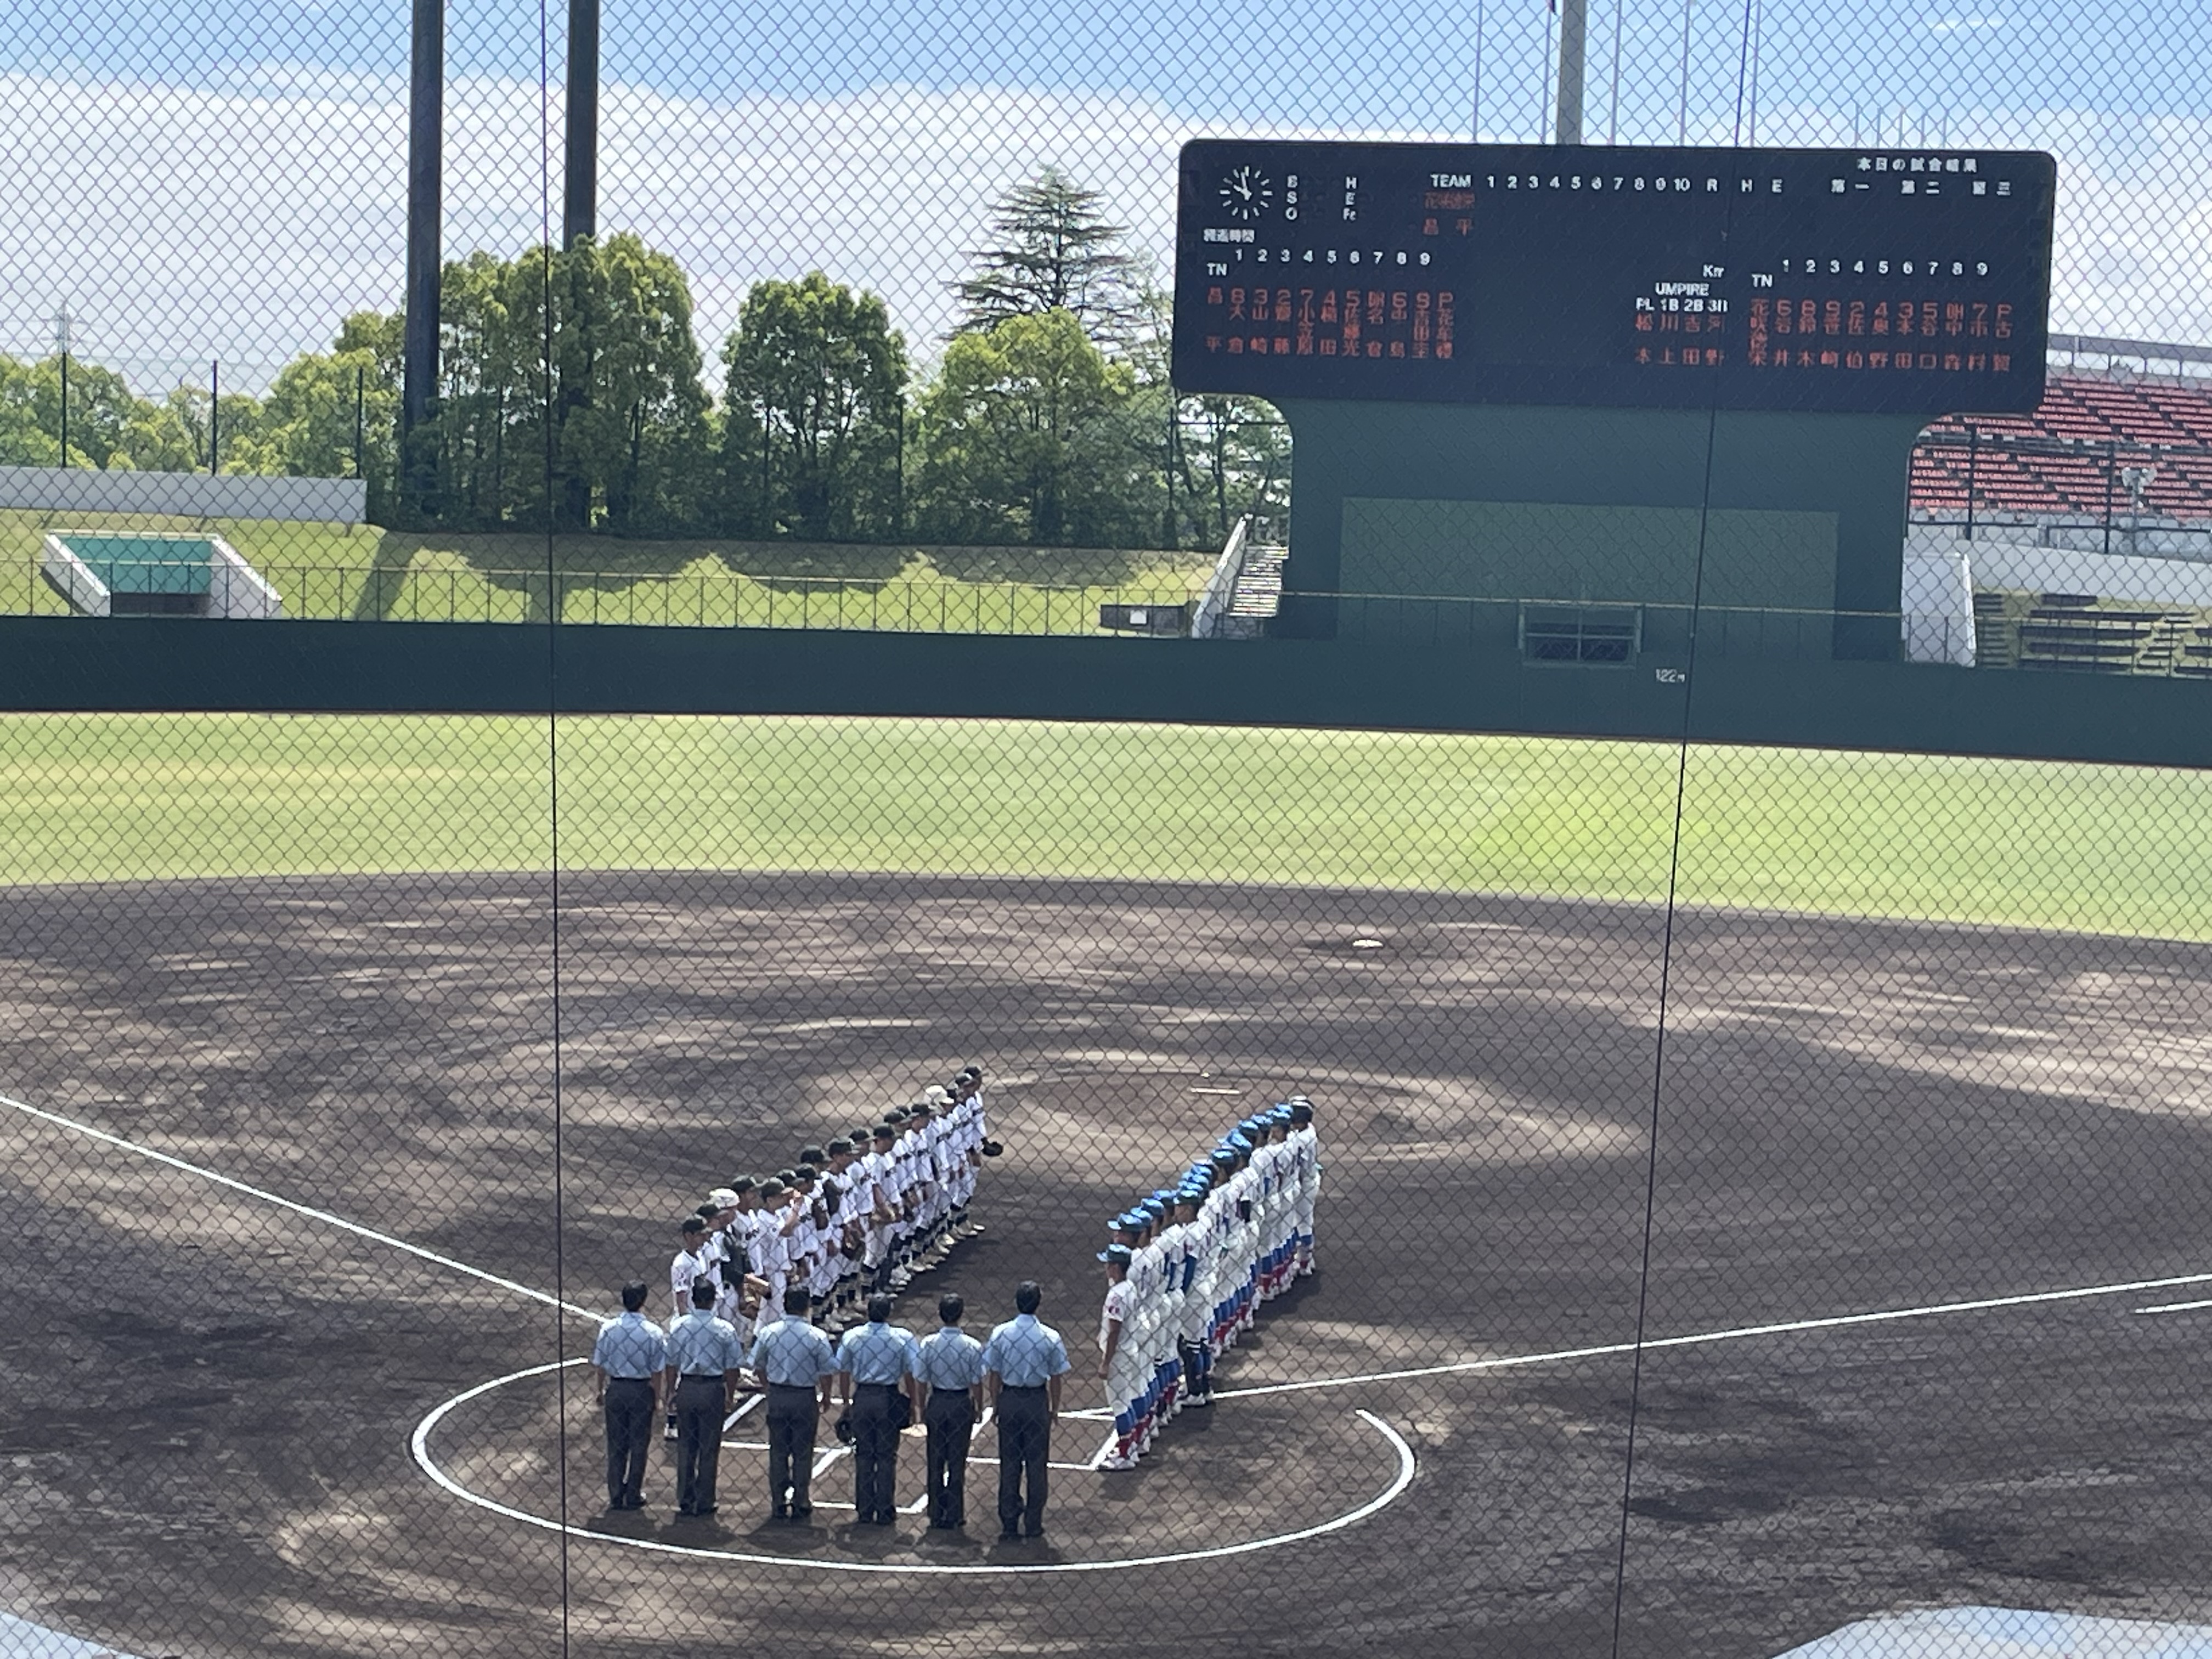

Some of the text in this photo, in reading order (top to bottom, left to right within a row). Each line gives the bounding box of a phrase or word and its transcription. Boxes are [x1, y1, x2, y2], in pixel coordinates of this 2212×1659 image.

[1346, 176, 1357, 189] H
[1430, 174, 1782, 193] TEAM 1 2 3 4 5 6 7 8 9 10 R H E
[1286, 191, 1297, 204] S
[1345, 192, 1356, 205] E
[1235, 249, 1430, 266] 1 2 3 4 5 6 7 8 9
[1206, 262, 1227, 276] TN
[1782, 259, 1988, 275] 1 2 3 4 5 6 7 8 9
[1655, 282, 1709, 296] UMPIRE
[1751, 274, 1773, 287] TN
[1231, 287, 1245, 306] 8
[1254, 288, 1268, 306] 3
[1277, 289, 1291, 307] 2
[1300, 289, 1313, 306] 7
[1323, 290, 1336, 305] 4
[1346, 290, 1361, 308] 5
[1392, 292, 1407, 308] 6
[1416, 292, 1430, 309] 9
[1438, 292, 1453, 308] P
[1660, 298, 1679, 312] 1B
[1684, 298, 1703, 312] 2B
[1777, 299, 1792, 317] 6
[1801, 300, 1816, 319] 8
[1825, 300, 1841, 319] 9
[1849, 301, 1865, 318] 2
[1874, 301, 1888, 319] 4
[1898, 302, 1914, 320] 3
[1923, 302, 1938, 320] 5
[1972, 303, 1988, 319] 7
[1997, 303, 2012, 319] P
[1660, 314, 1679, 364] 川上
